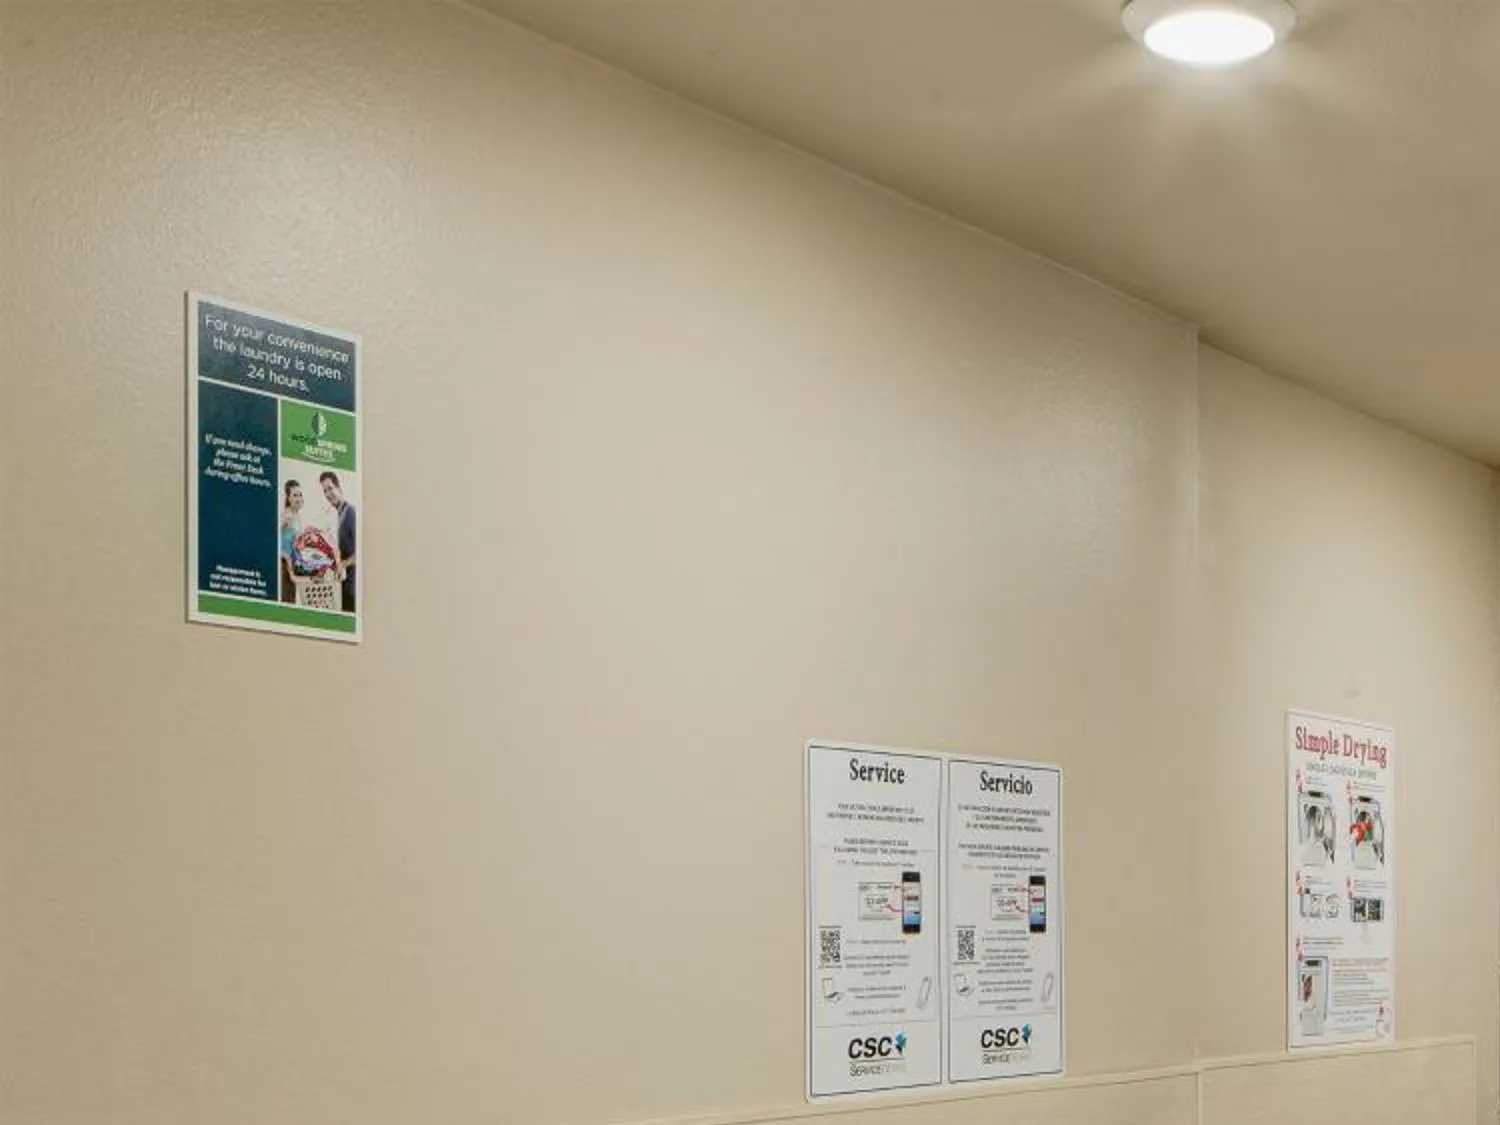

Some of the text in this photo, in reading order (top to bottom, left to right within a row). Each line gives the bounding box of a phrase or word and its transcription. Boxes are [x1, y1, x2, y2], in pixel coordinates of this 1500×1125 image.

[205, 313, 349, 363] For your convenience
[213, 336, 342, 381] the laundry is open
[247, 365, 309, 392] 24 hours.
[1295, 726, 1387, 769] Simple Drying
[849, 758, 905, 784] Service
[979, 770, 1033, 795] Servicio
[848, 1036, 892, 1059] CSC
[981, 1027, 1019, 1049] CSC
